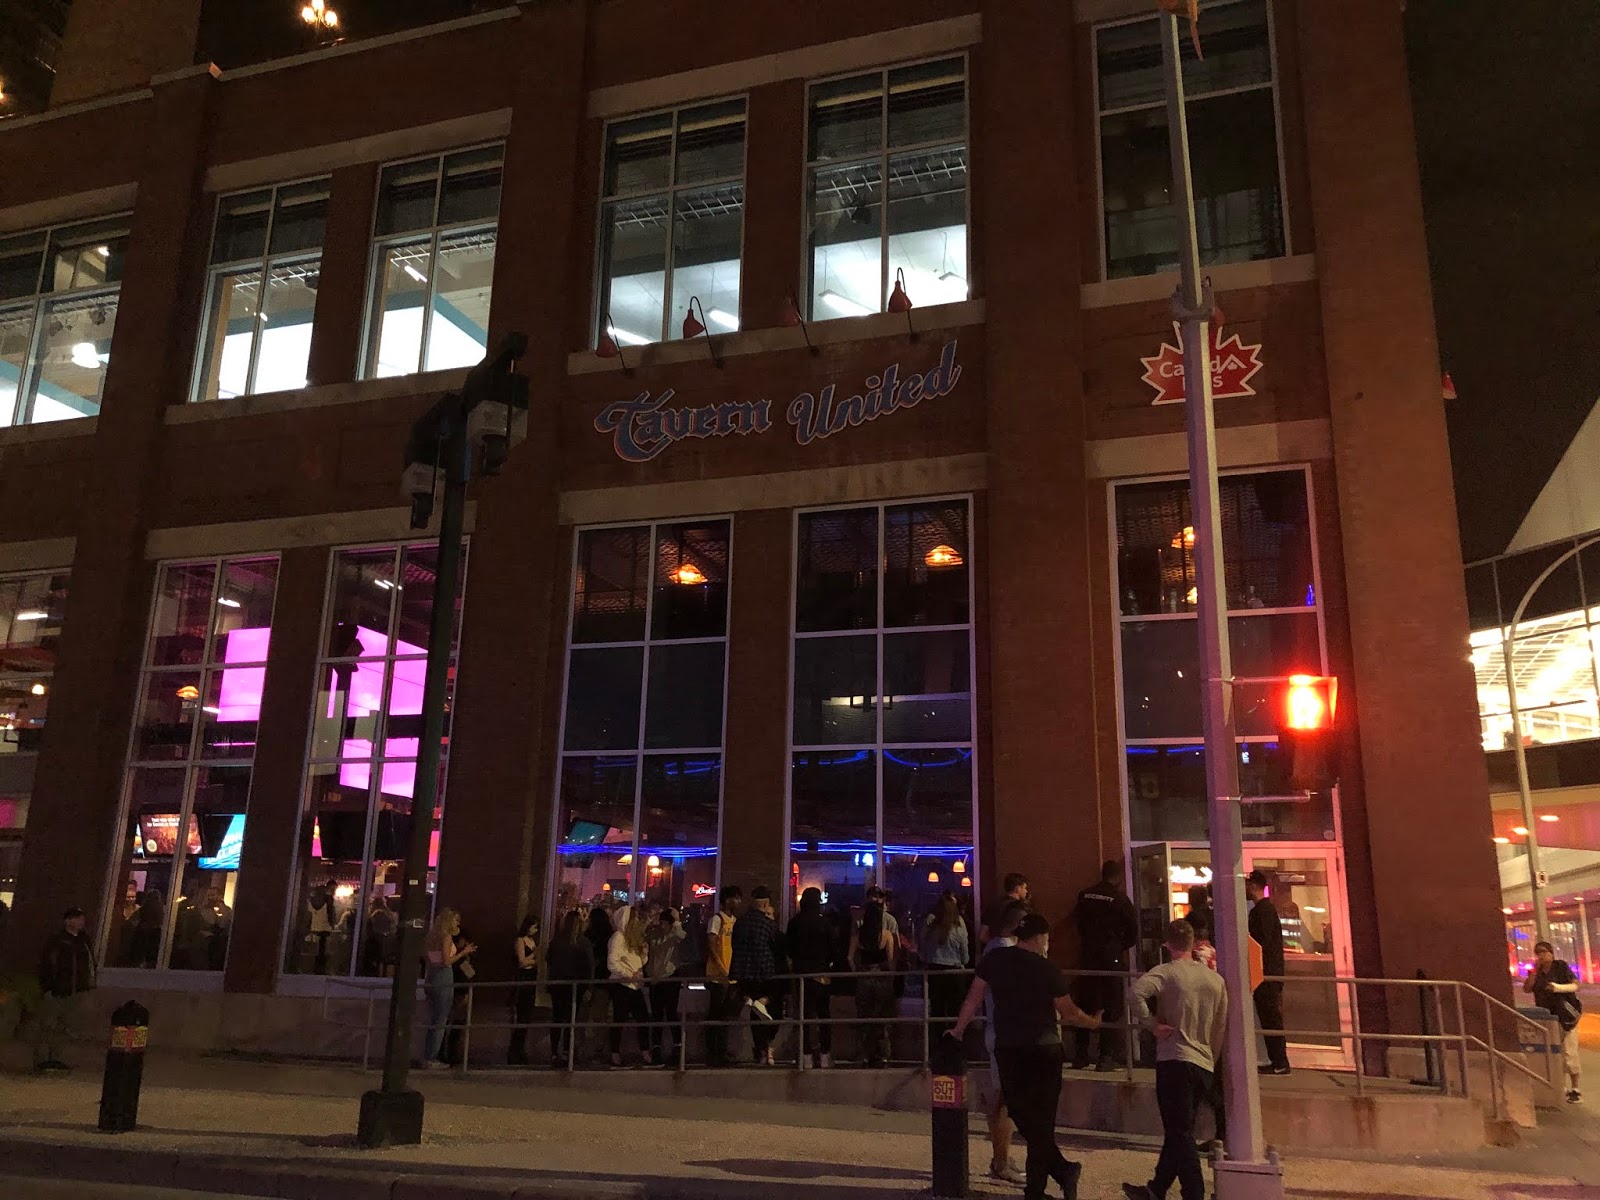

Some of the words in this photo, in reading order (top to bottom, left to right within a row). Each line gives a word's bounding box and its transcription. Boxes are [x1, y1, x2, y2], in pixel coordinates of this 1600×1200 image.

[1160, 355, 1221, 378] Cad
[594, 388, 773, 462] Tavern
[786, 339, 962, 446] United
[1084, 893, 1115, 902] SECURITY
